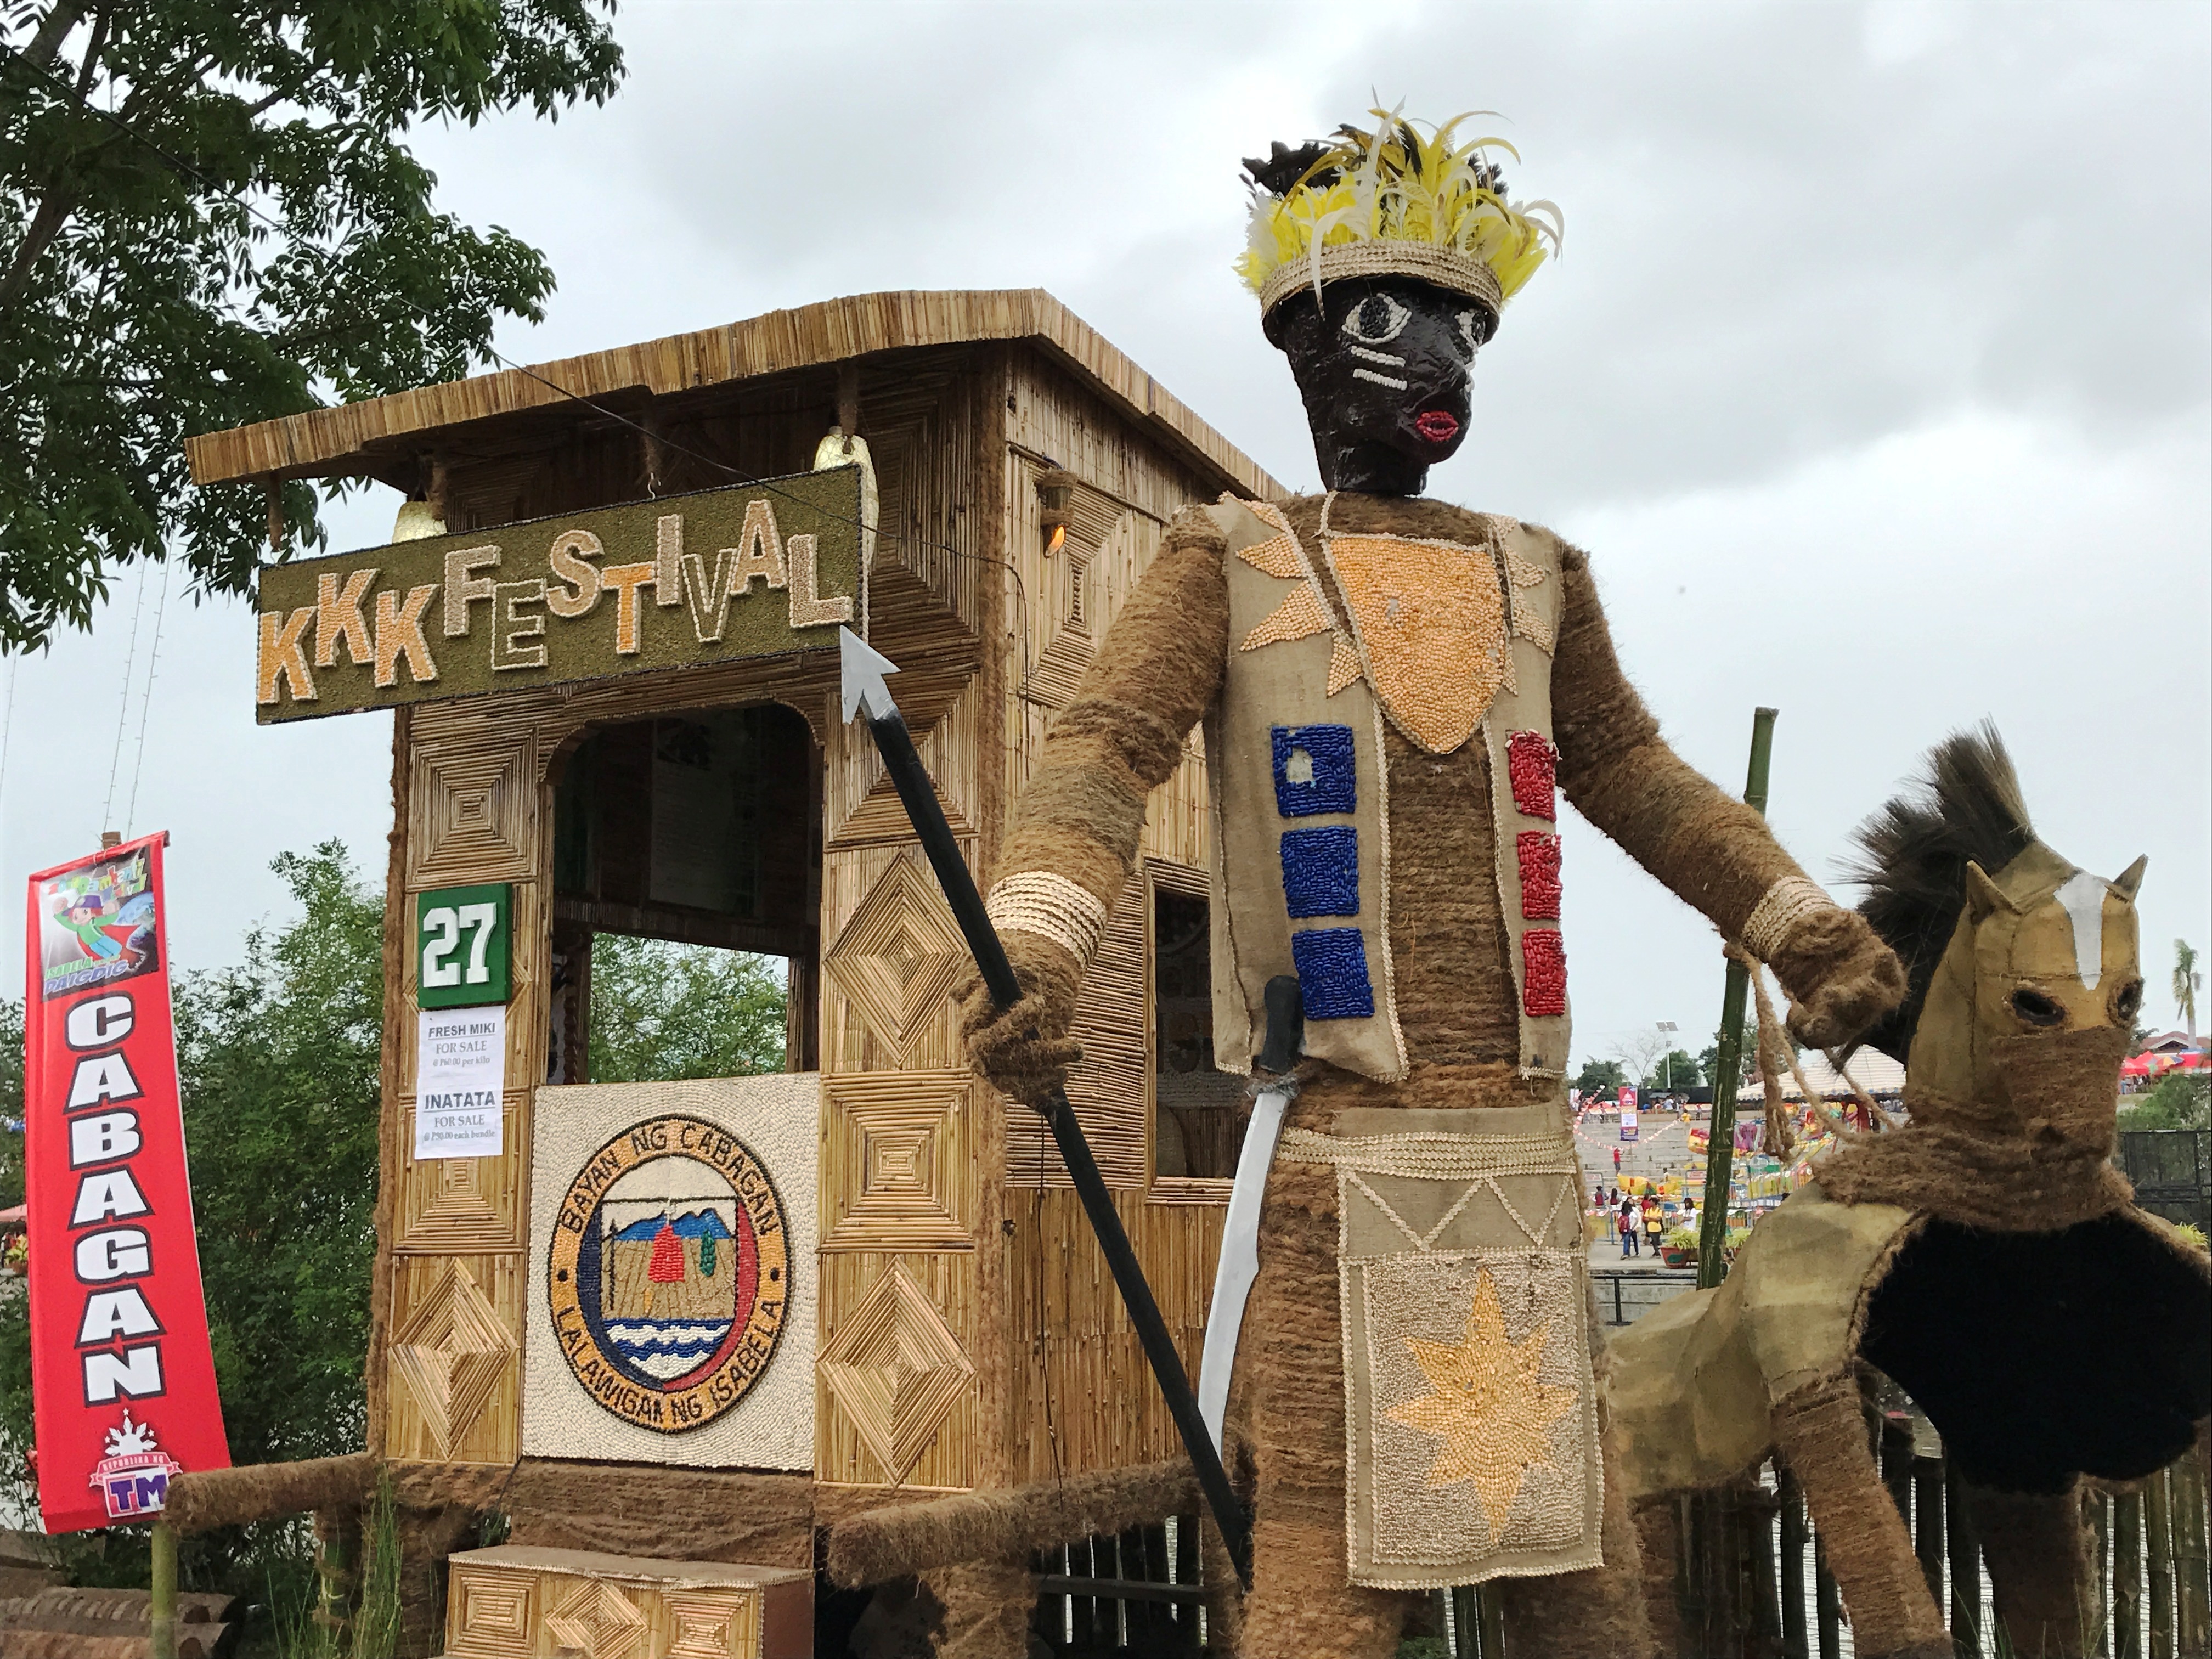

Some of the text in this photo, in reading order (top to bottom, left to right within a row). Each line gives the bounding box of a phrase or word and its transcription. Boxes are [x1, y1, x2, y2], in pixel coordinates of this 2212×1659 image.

[257, 499, 854, 706] KKK FESTIVAL
[423, 902, 497, 988] 27
[44, 956, 93, 980] ISABELA
[44, 959, 129, 995] DAIGDIG
[428, 1022, 495, 1038] FRESH MIKI
[436, 1040, 487, 1054] FOR SALE
[462, 1058, 474, 1068] per
[475, 1055, 490, 1064] kilo
[425, 1091, 496, 1109] INATATA
[435, 1114, 485, 1127] FOR SALE
[454, 1130, 470, 1139] each
[471, 1129, 495, 1138] bundle
[560, 1124, 778, 1235] BAYAN NG CABAGAN
[63, 990, 166, 1408] CABAGAN
[556, 1299, 782, 1424] LALAWIGAN NG ISABELA
[110, 1474, 167, 1510] TM
